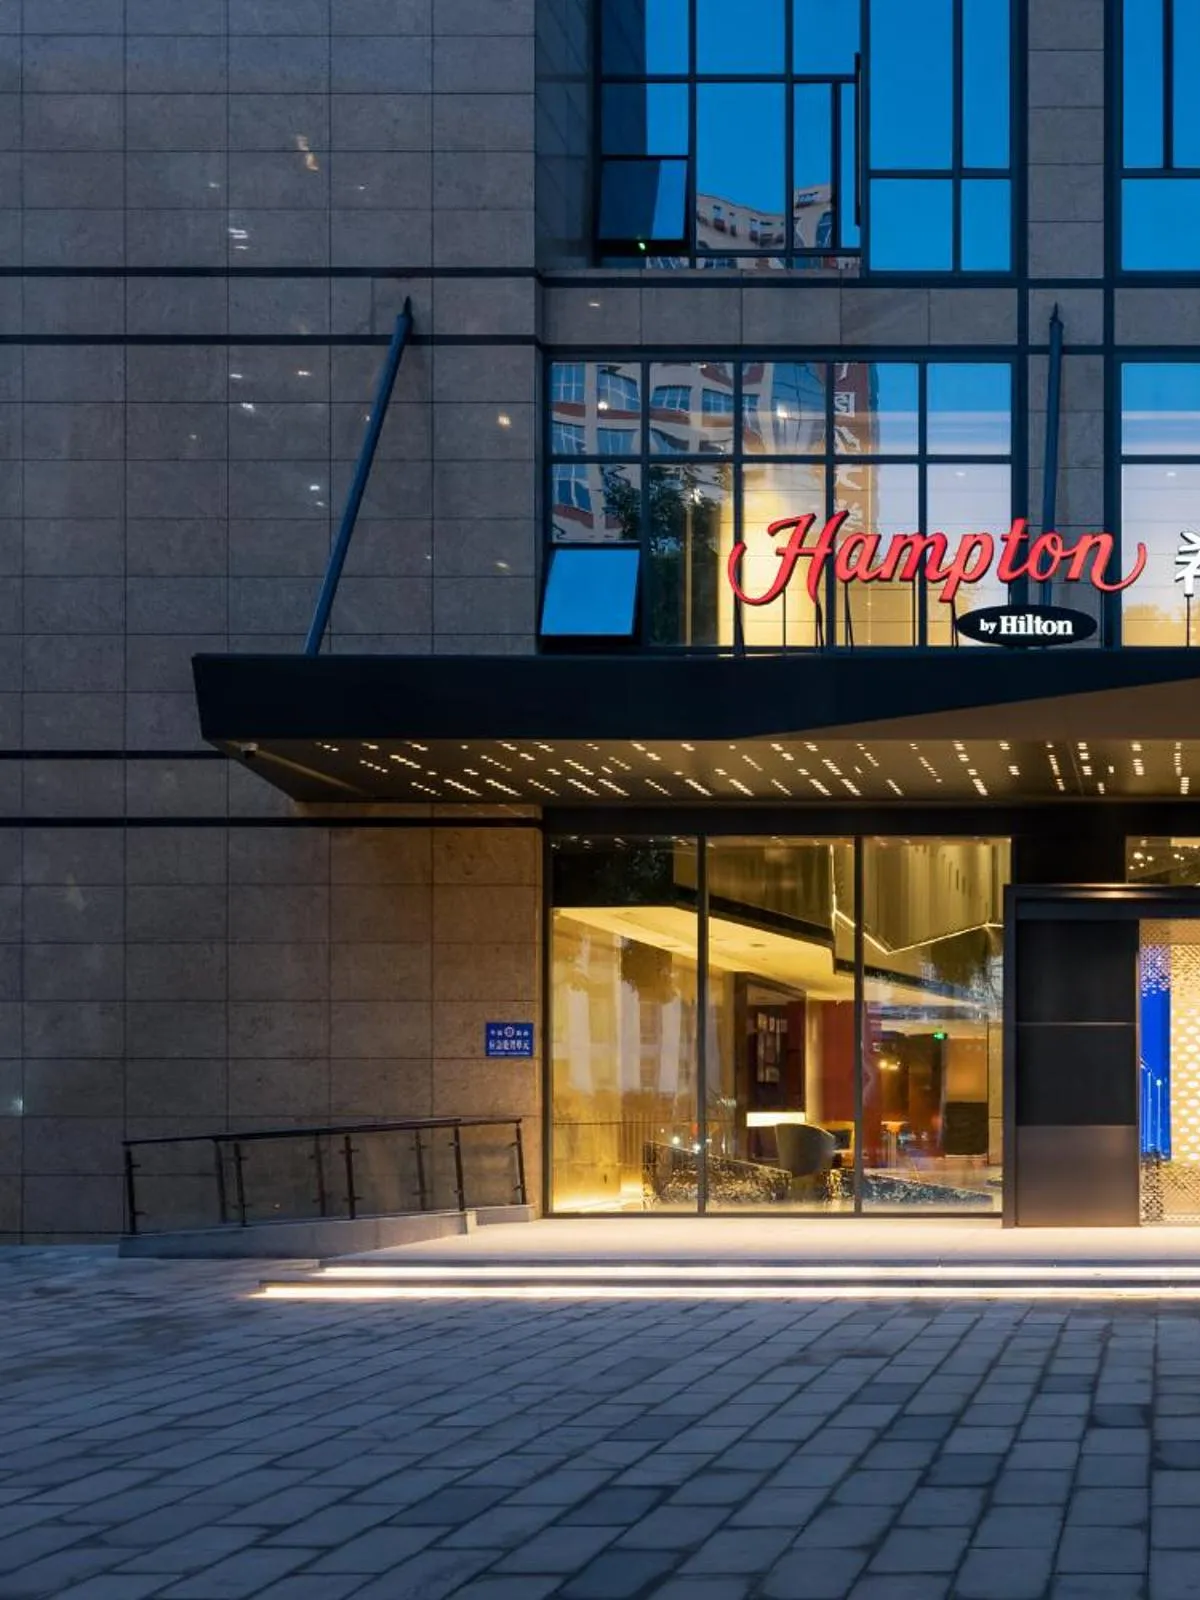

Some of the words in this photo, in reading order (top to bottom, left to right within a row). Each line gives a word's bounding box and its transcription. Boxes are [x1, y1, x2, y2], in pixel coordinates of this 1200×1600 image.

[729, 510, 1147, 606] Hampton
[980, 618, 998, 634] by
[999, 613, 1074, 635] Hilton
